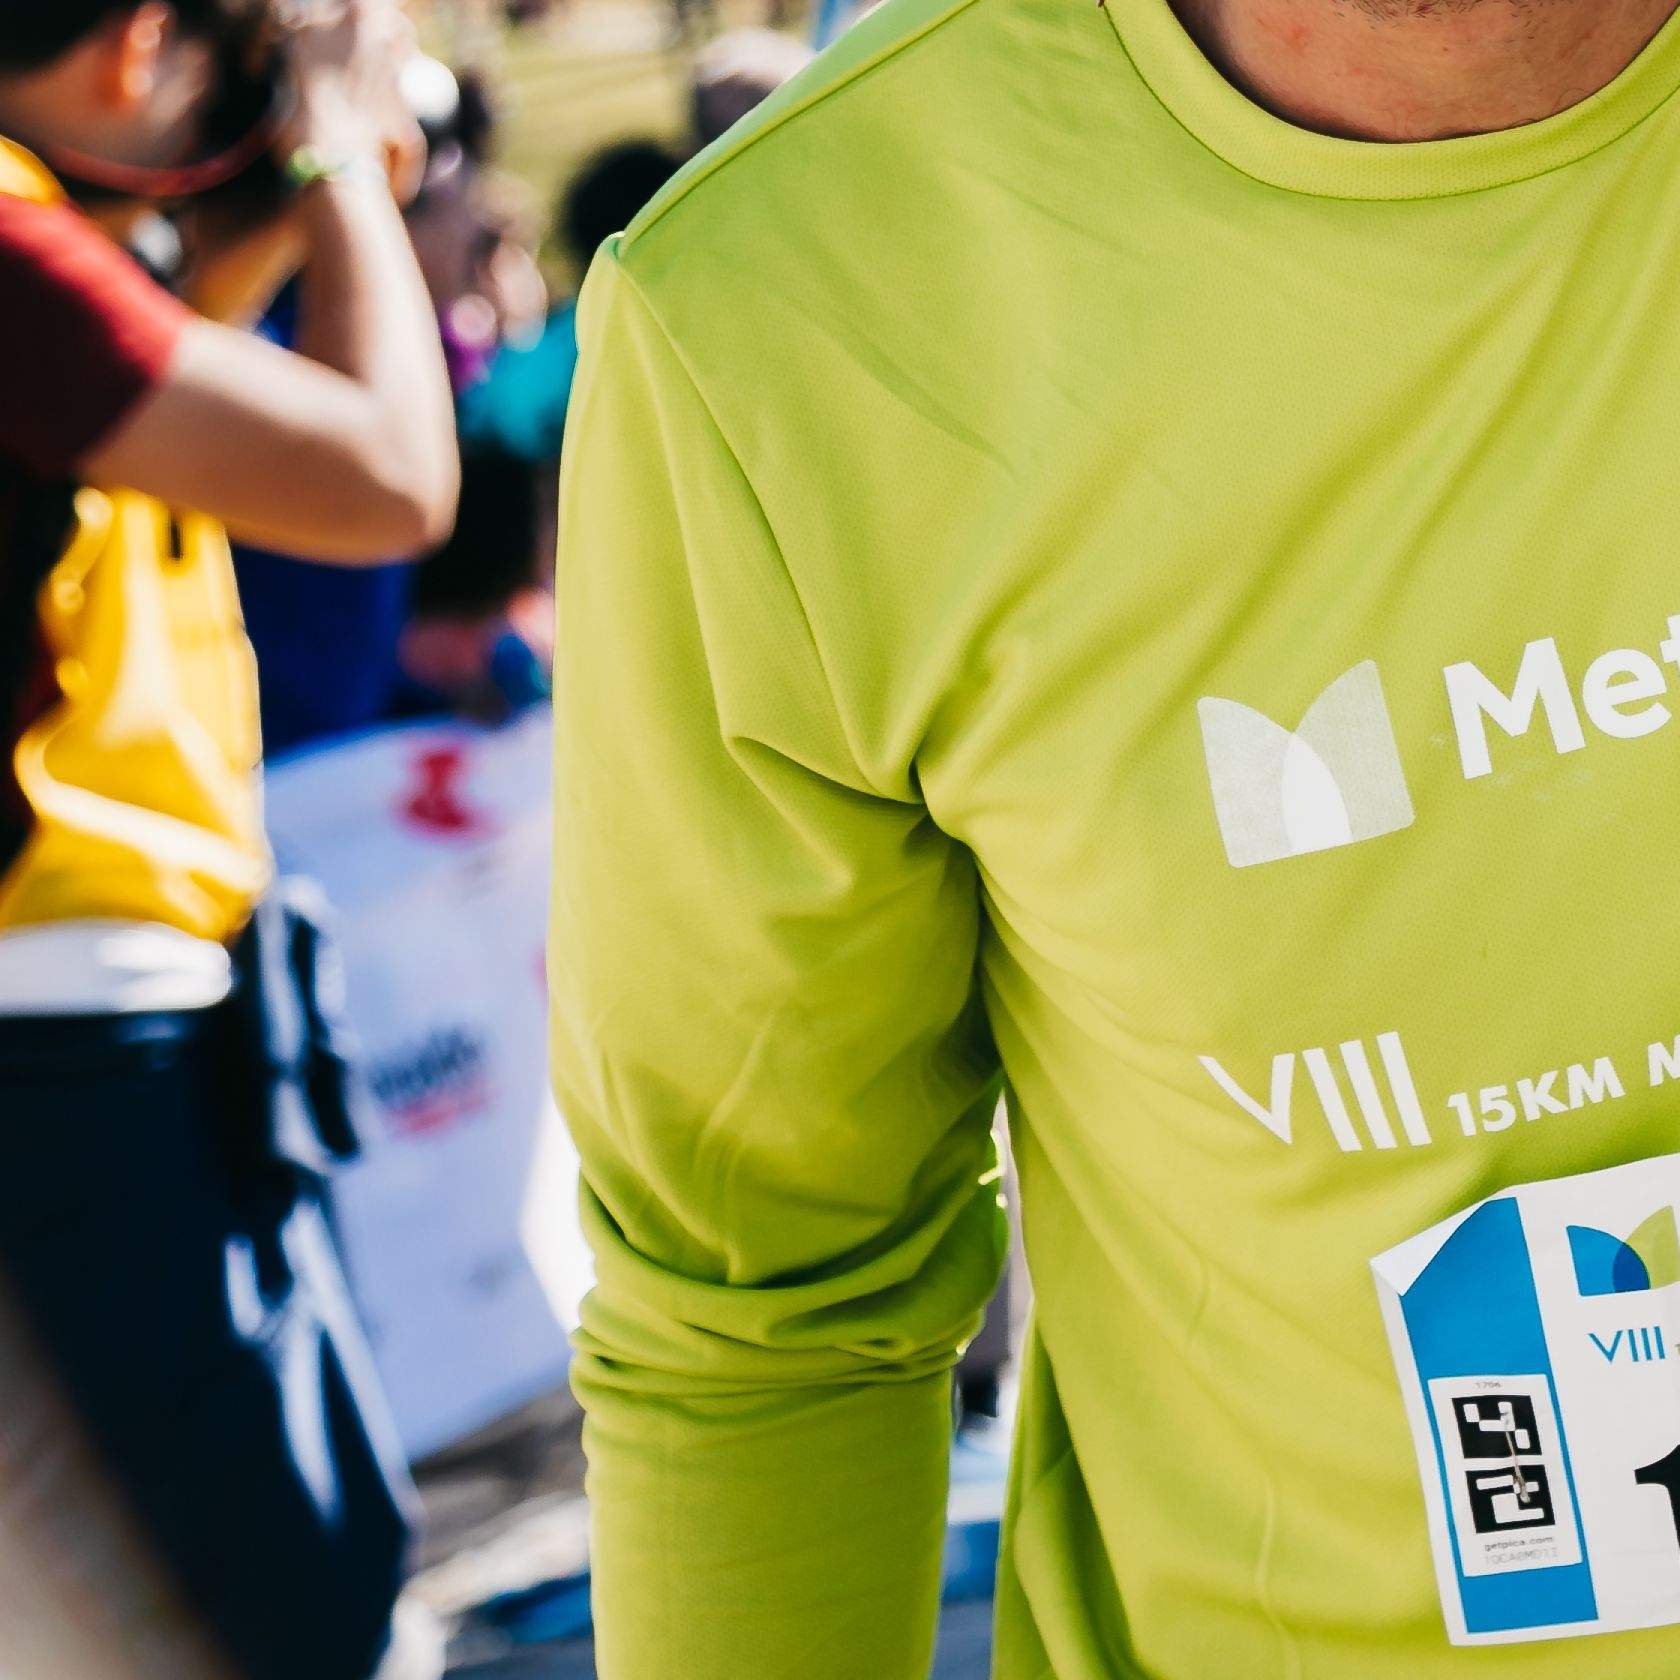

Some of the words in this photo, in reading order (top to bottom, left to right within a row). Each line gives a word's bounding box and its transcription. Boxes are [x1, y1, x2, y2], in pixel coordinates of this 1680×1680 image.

[1198, 1029, 1432, 1152] VIII
[1446, 1055, 1626, 1138] 15KM
[1588, 1325, 1666, 1363] VIII
